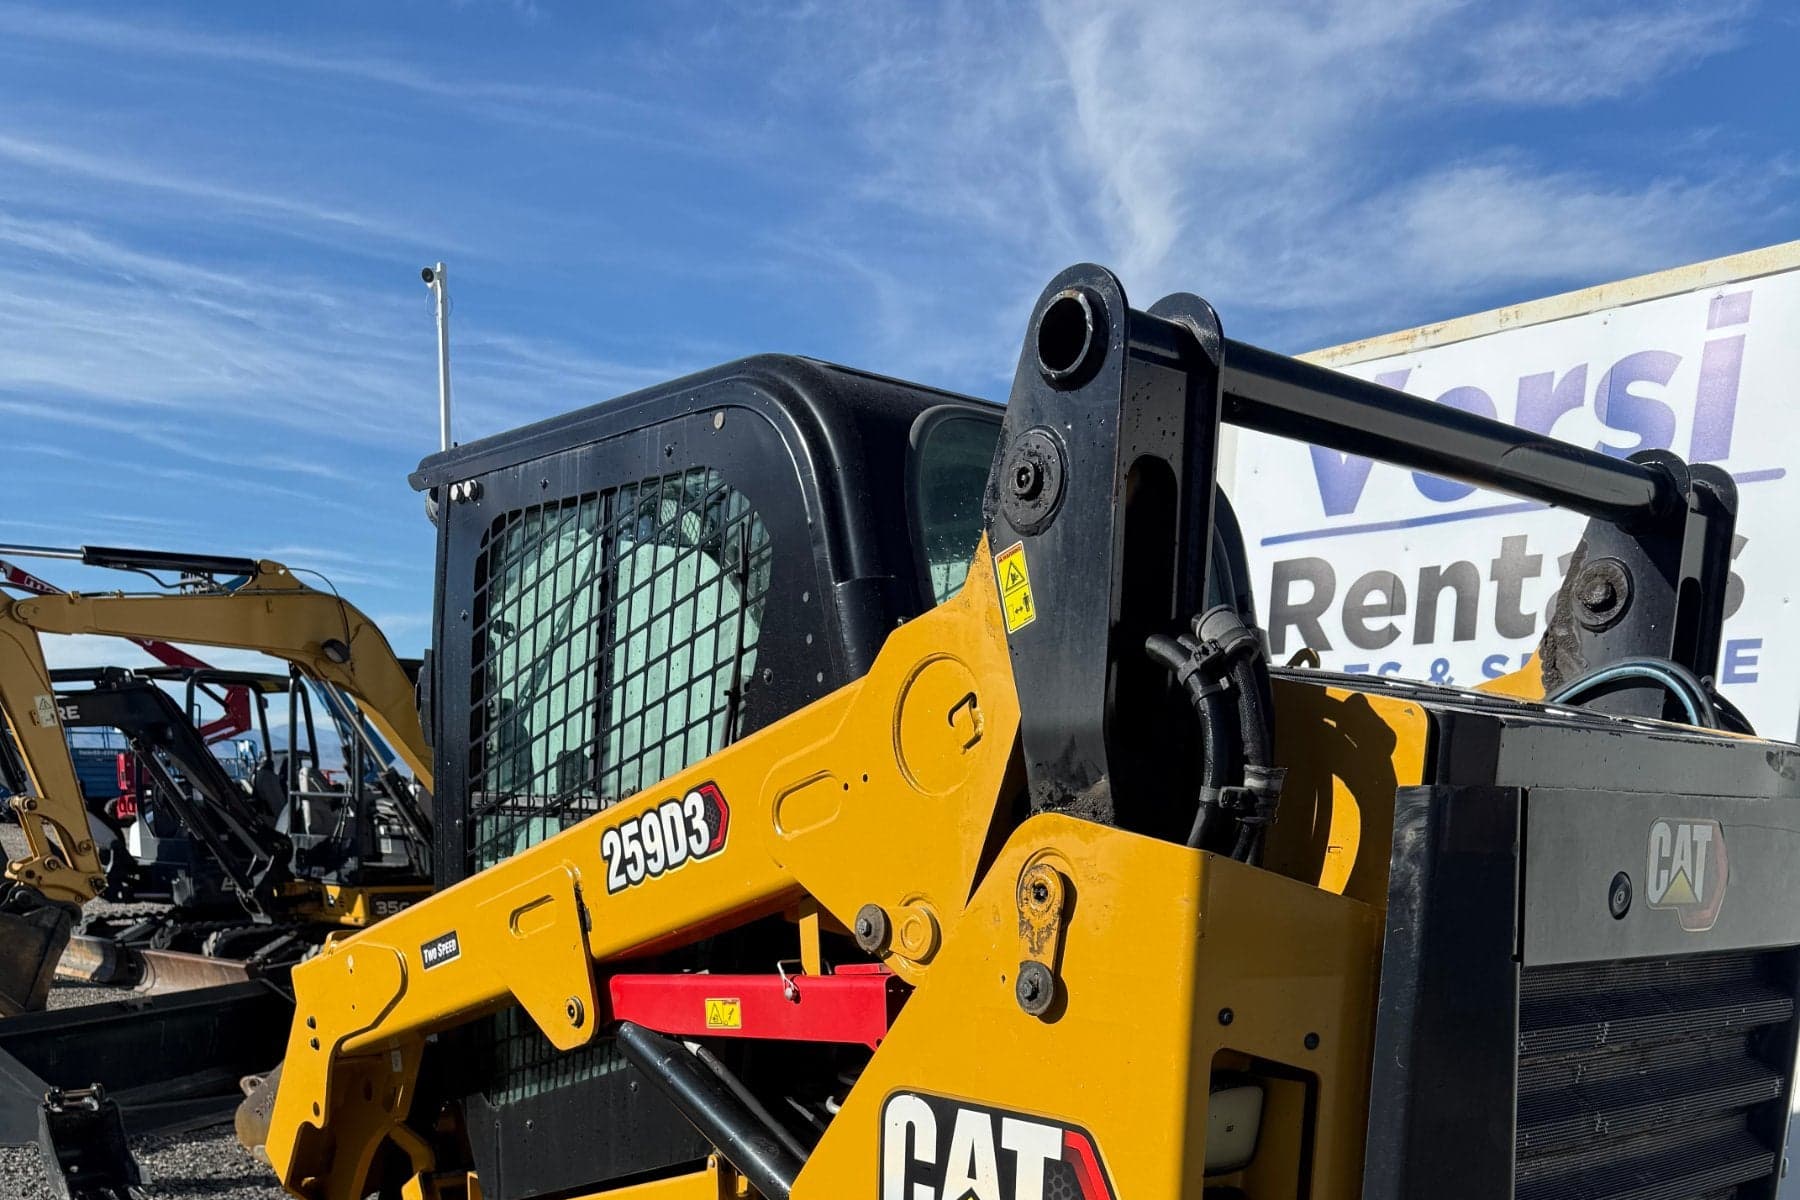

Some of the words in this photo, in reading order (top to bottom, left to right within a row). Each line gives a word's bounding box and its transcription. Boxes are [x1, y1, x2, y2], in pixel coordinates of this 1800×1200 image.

[1268, 534, 1749, 656] Rent
[602, 791, 710, 892] 259D3
[1648, 821, 1713, 904] CAT
